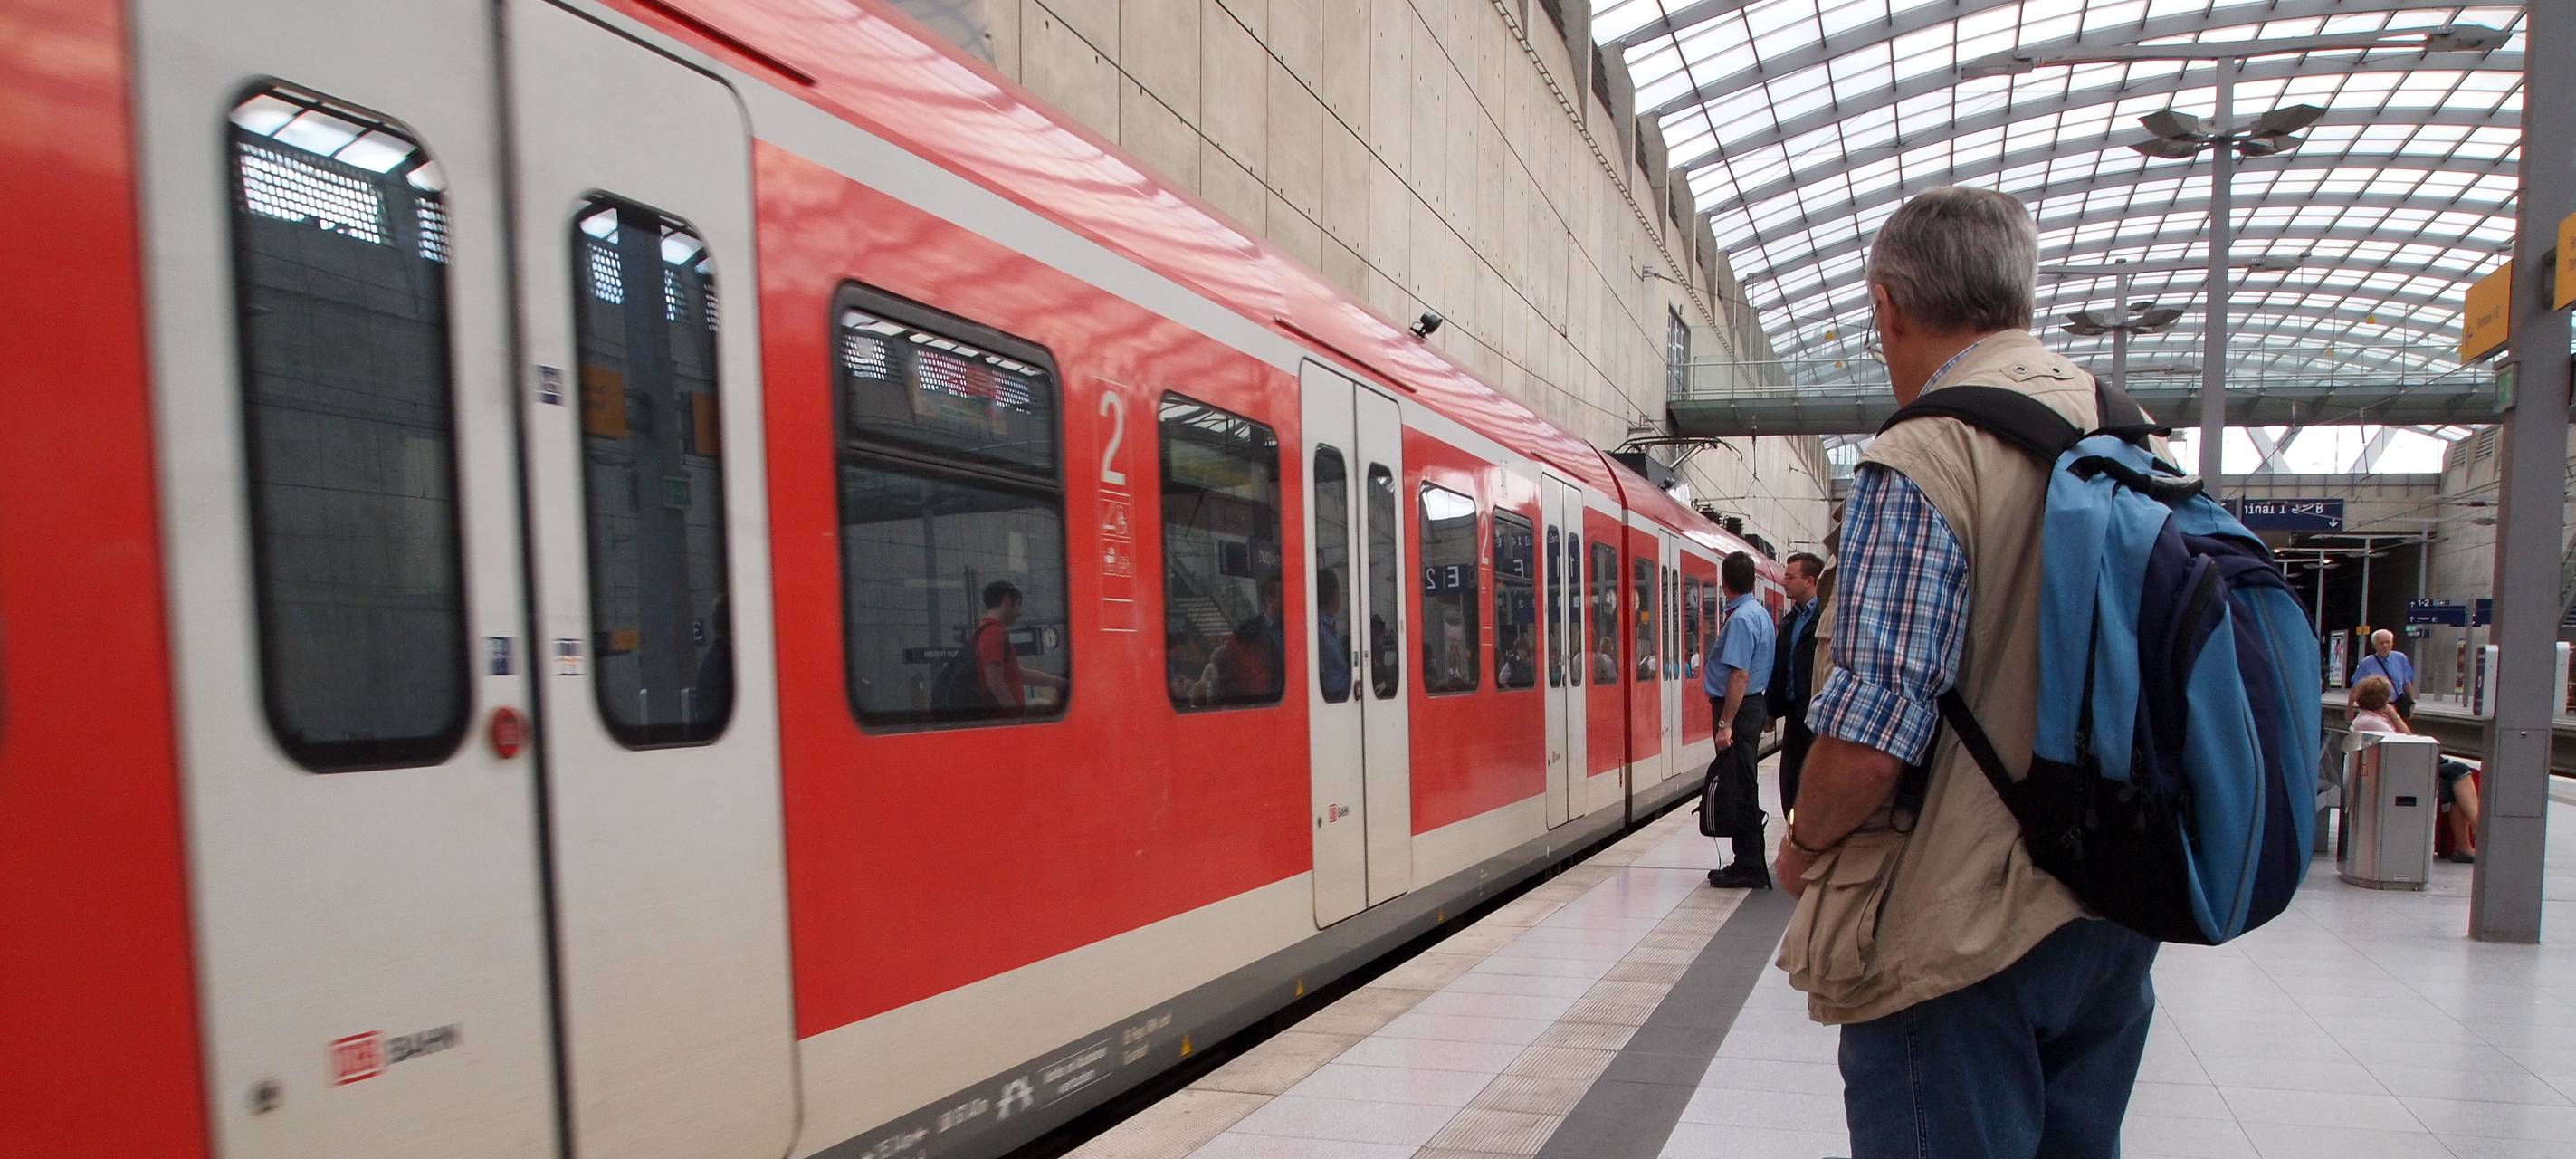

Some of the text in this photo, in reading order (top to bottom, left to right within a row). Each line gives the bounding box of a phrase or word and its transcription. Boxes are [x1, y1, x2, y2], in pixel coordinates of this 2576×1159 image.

[1099, 390, 1126, 485] 2
[1480, 512, 1490, 565] 2
[2418, 599, 2430, 608] 1-2
